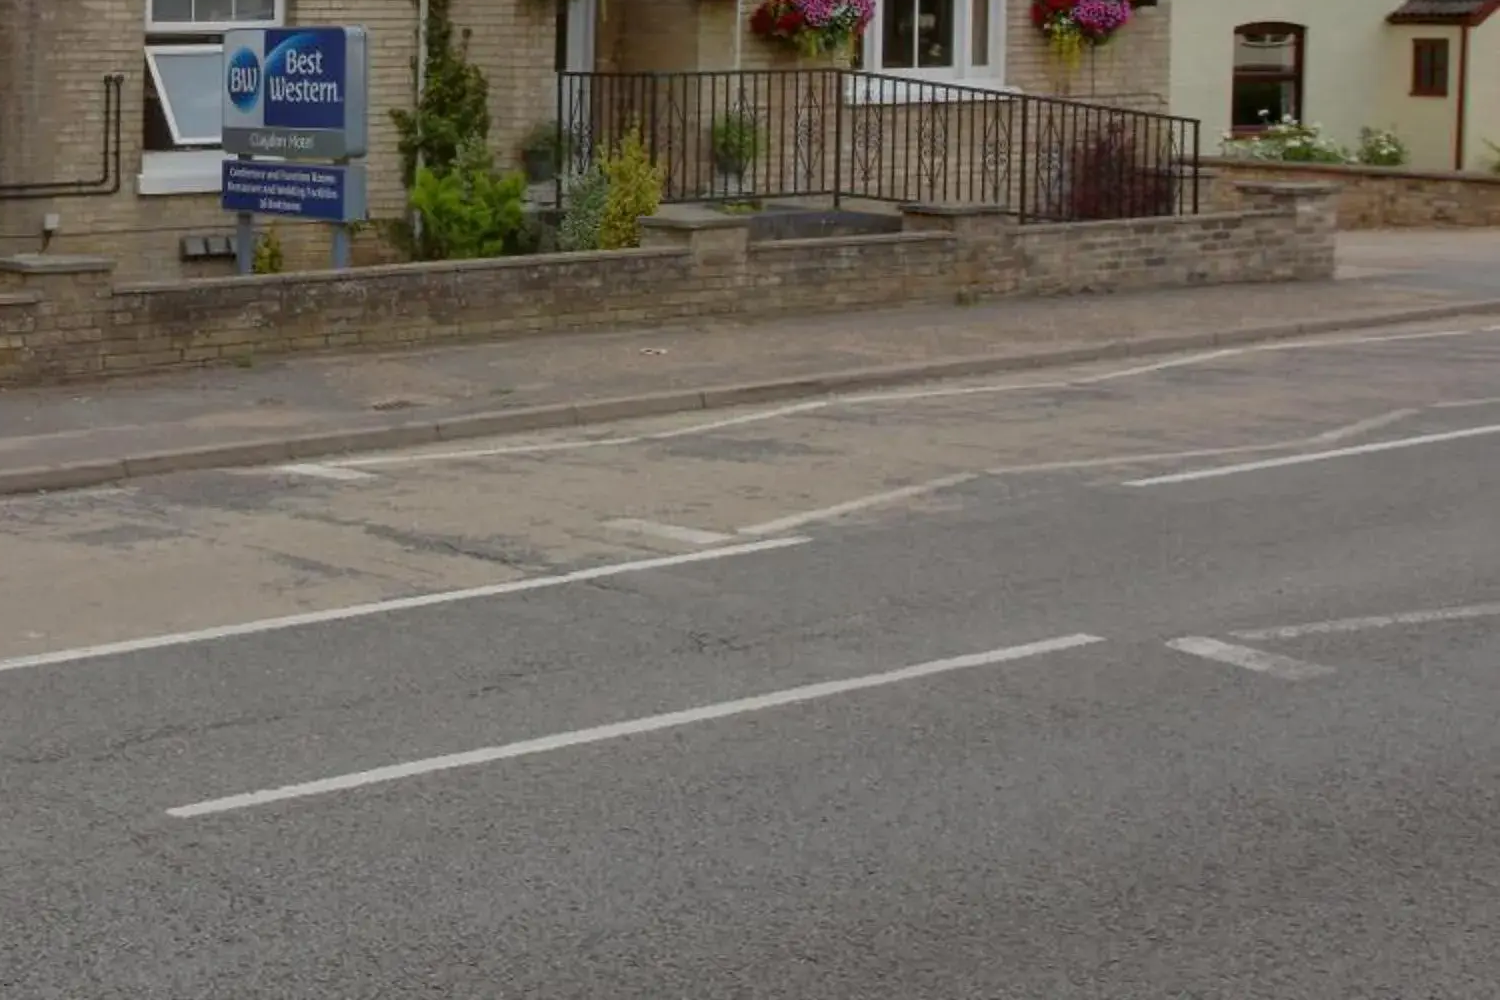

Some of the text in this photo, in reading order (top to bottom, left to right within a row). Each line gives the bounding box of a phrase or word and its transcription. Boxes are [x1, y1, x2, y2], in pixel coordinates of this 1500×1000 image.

[286, 48, 323, 75] Best
[231, 67, 258, 93] BW
[269, 76, 340, 103] Western
